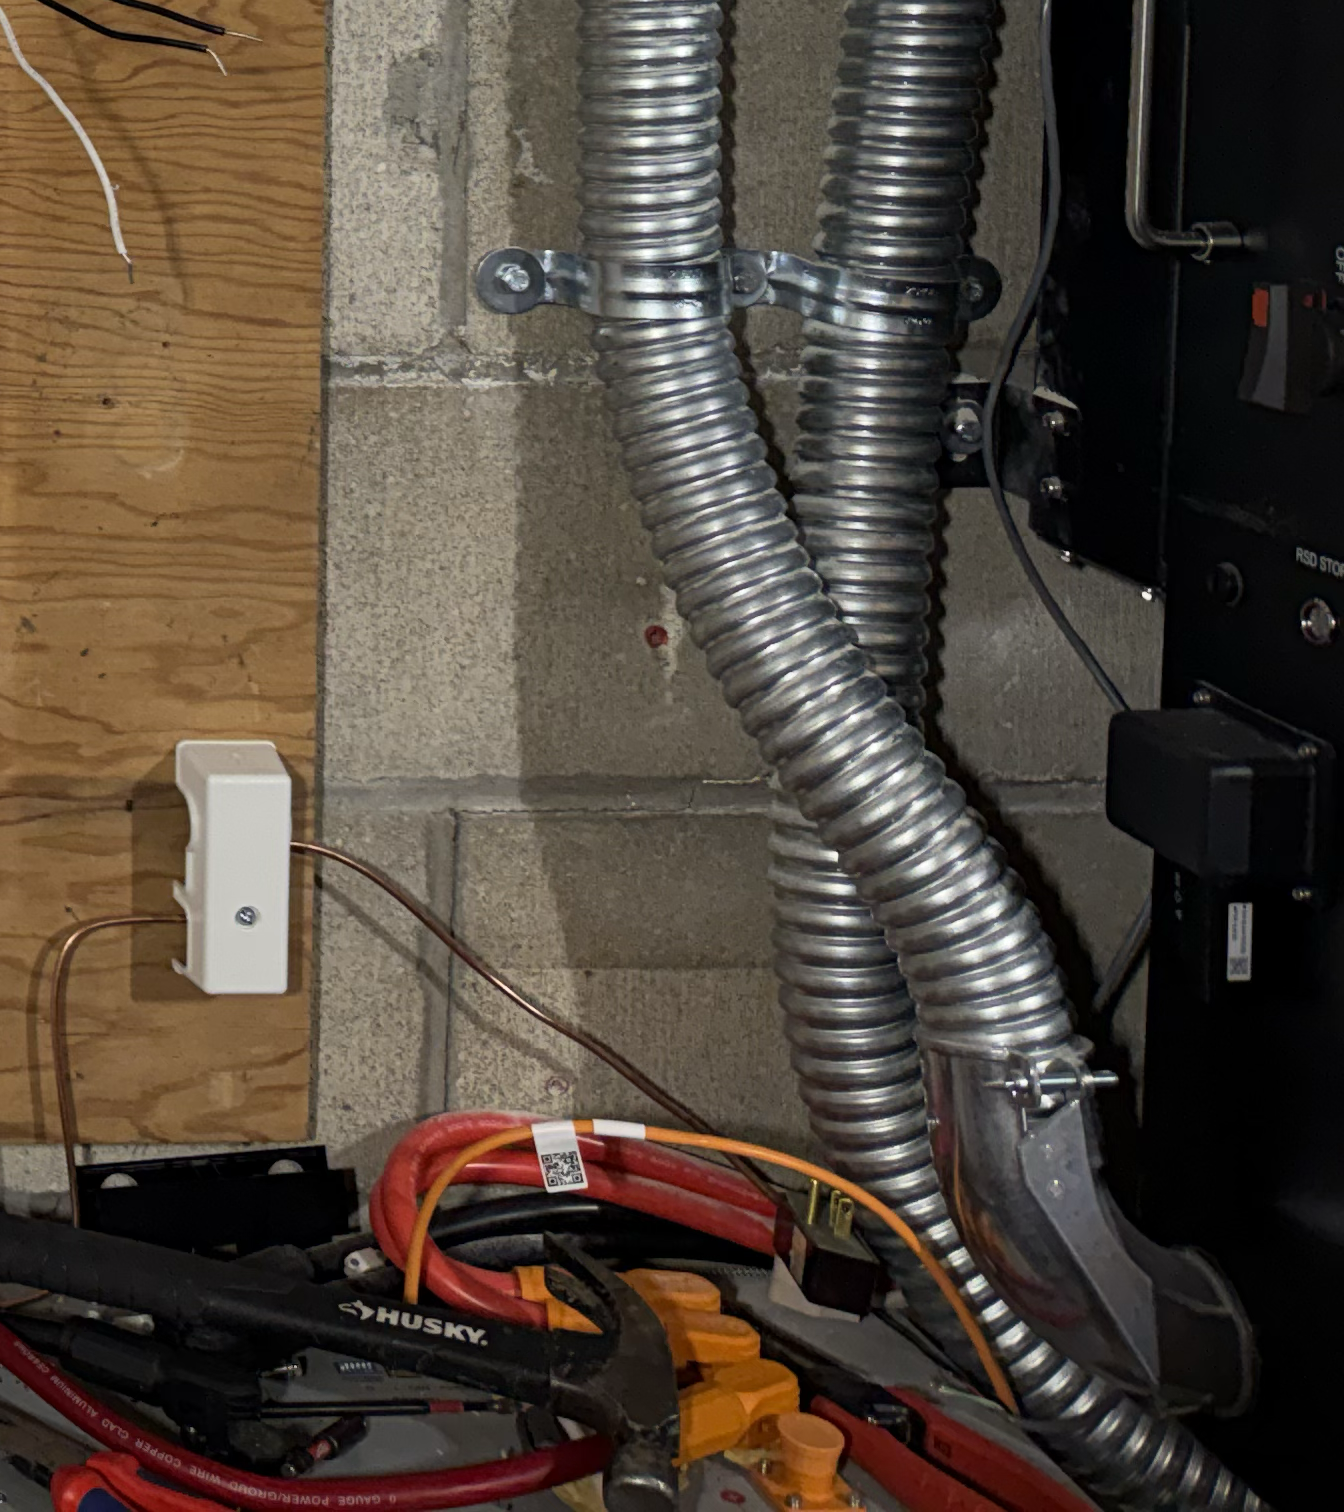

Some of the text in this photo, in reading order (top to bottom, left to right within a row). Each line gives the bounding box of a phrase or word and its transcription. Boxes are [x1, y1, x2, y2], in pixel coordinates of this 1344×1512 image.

[1295, 547, 1317, 569] RSD
[49, 1367, 99, 1419] ALUMINIUM
[100, 1418, 129, 1440] CLAD
[134, 1437, 182, 1469] COPPER
[188, 1464, 221, 1484] WIRE
[228, 1481, 330, 1506] POWER/GROUD
[337, 1494, 381, 1506] GAUGE
